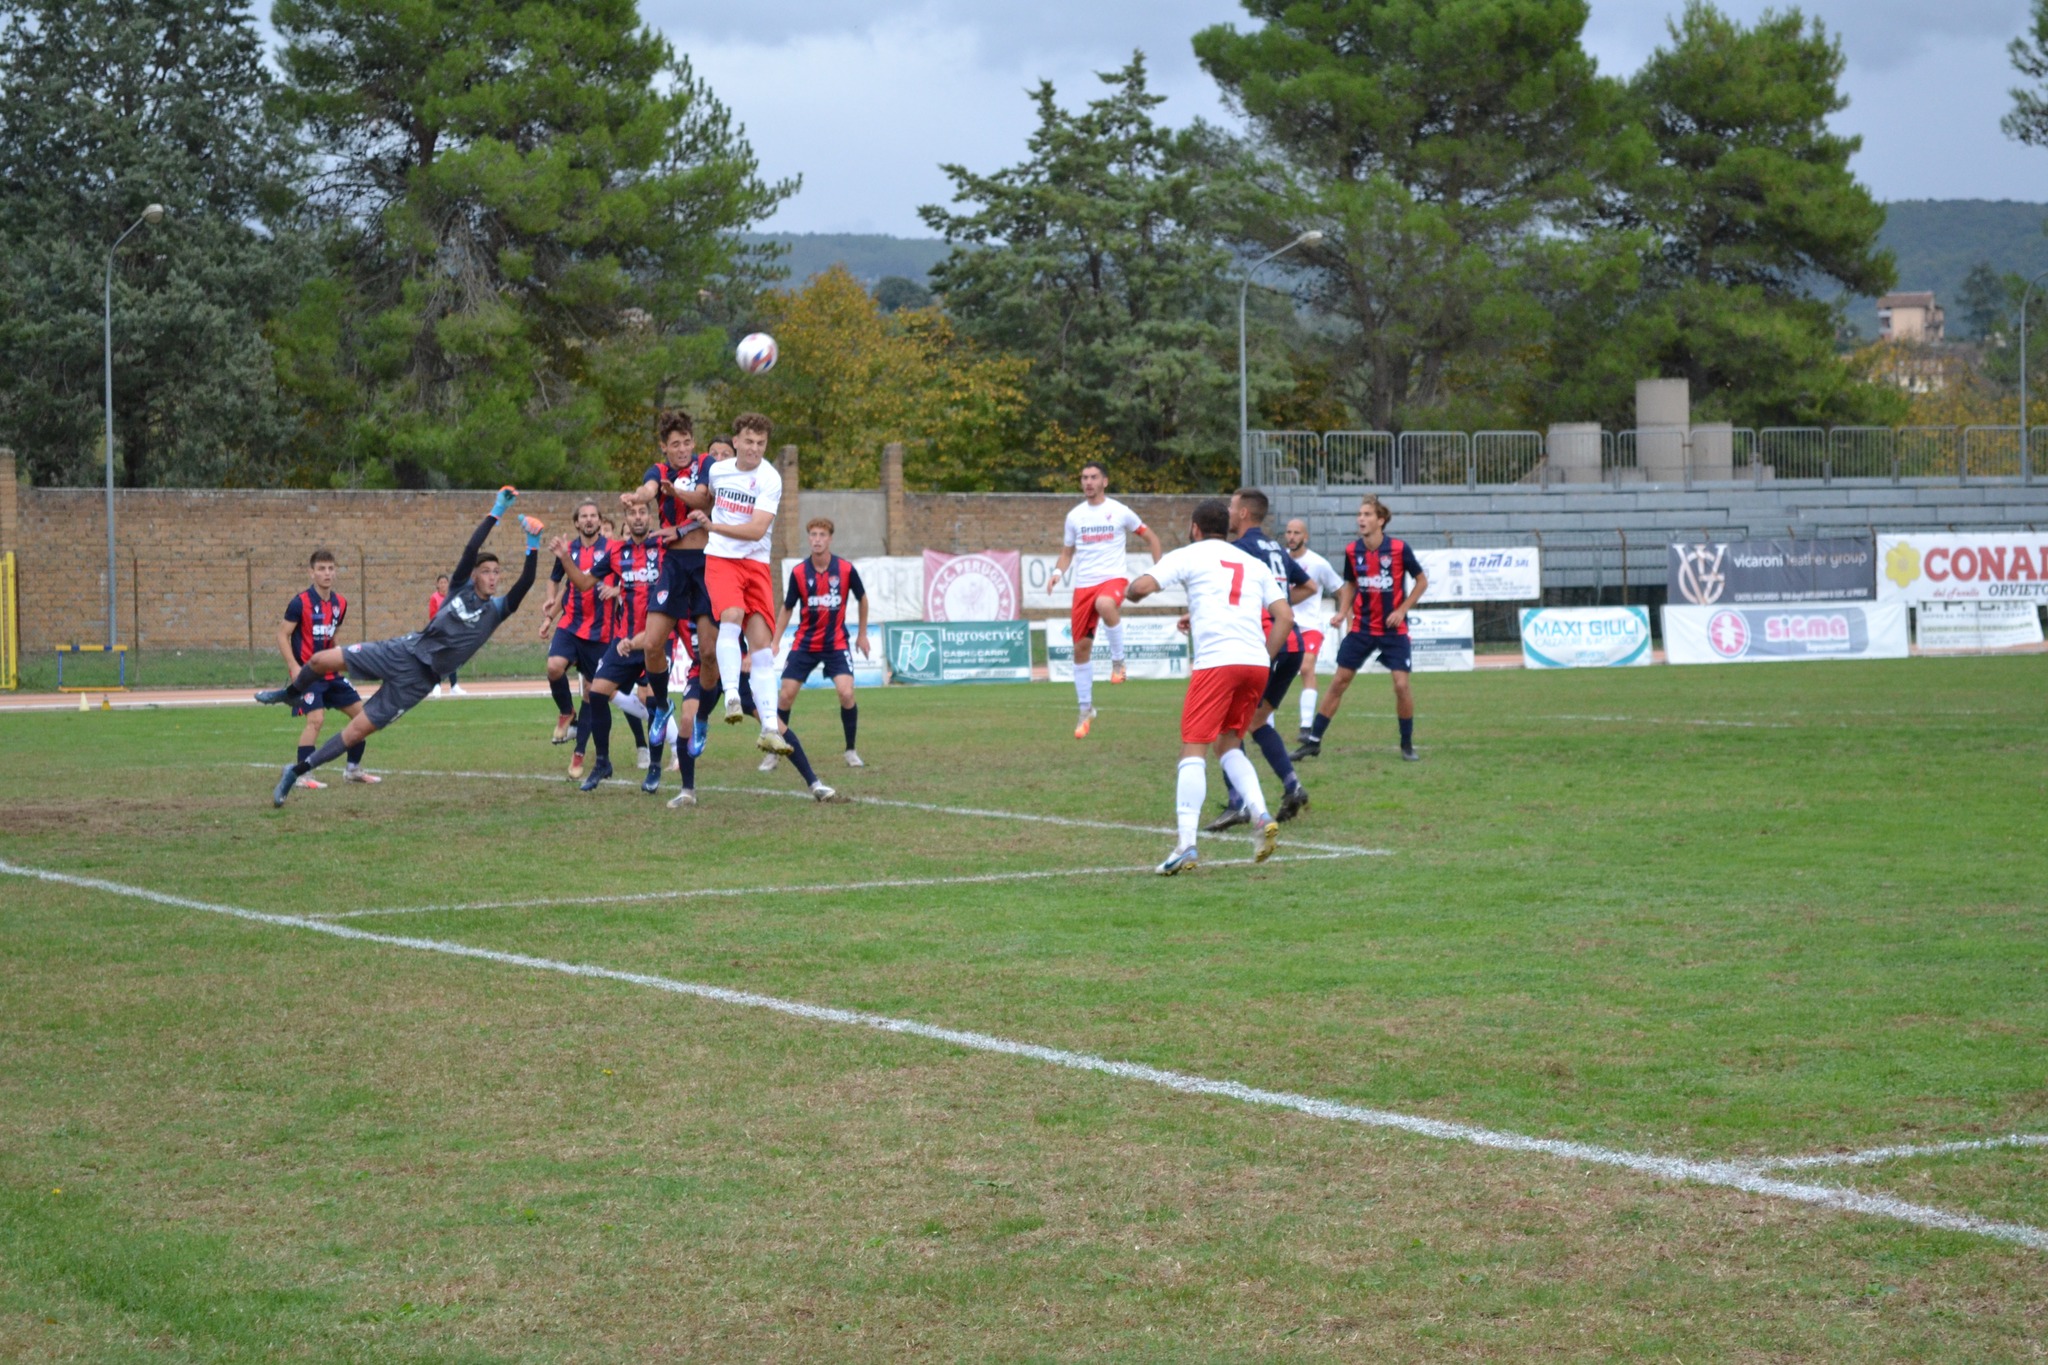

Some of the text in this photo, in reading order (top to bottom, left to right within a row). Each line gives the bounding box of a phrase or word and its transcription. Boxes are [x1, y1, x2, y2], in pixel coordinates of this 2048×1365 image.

[717, 487, 757, 504] Gruppo
[1080, 525, 1115, 533] Gruppo
[1734, 552, 1868, 568] vicaroni leather group
[1924, 546, 2048, 582] CONA
[621, 567, 660, 583] snep
[954, 560, 1007, 593] PERUGIA
[1220, 559, 1245, 607] 7
[1357, 574, 1394, 589] snep
[807, 593, 842, 608] snep
[1534, 619, 1638, 636] MAXI GIULI
[941, 627, 1024, 646] Ingroservice
